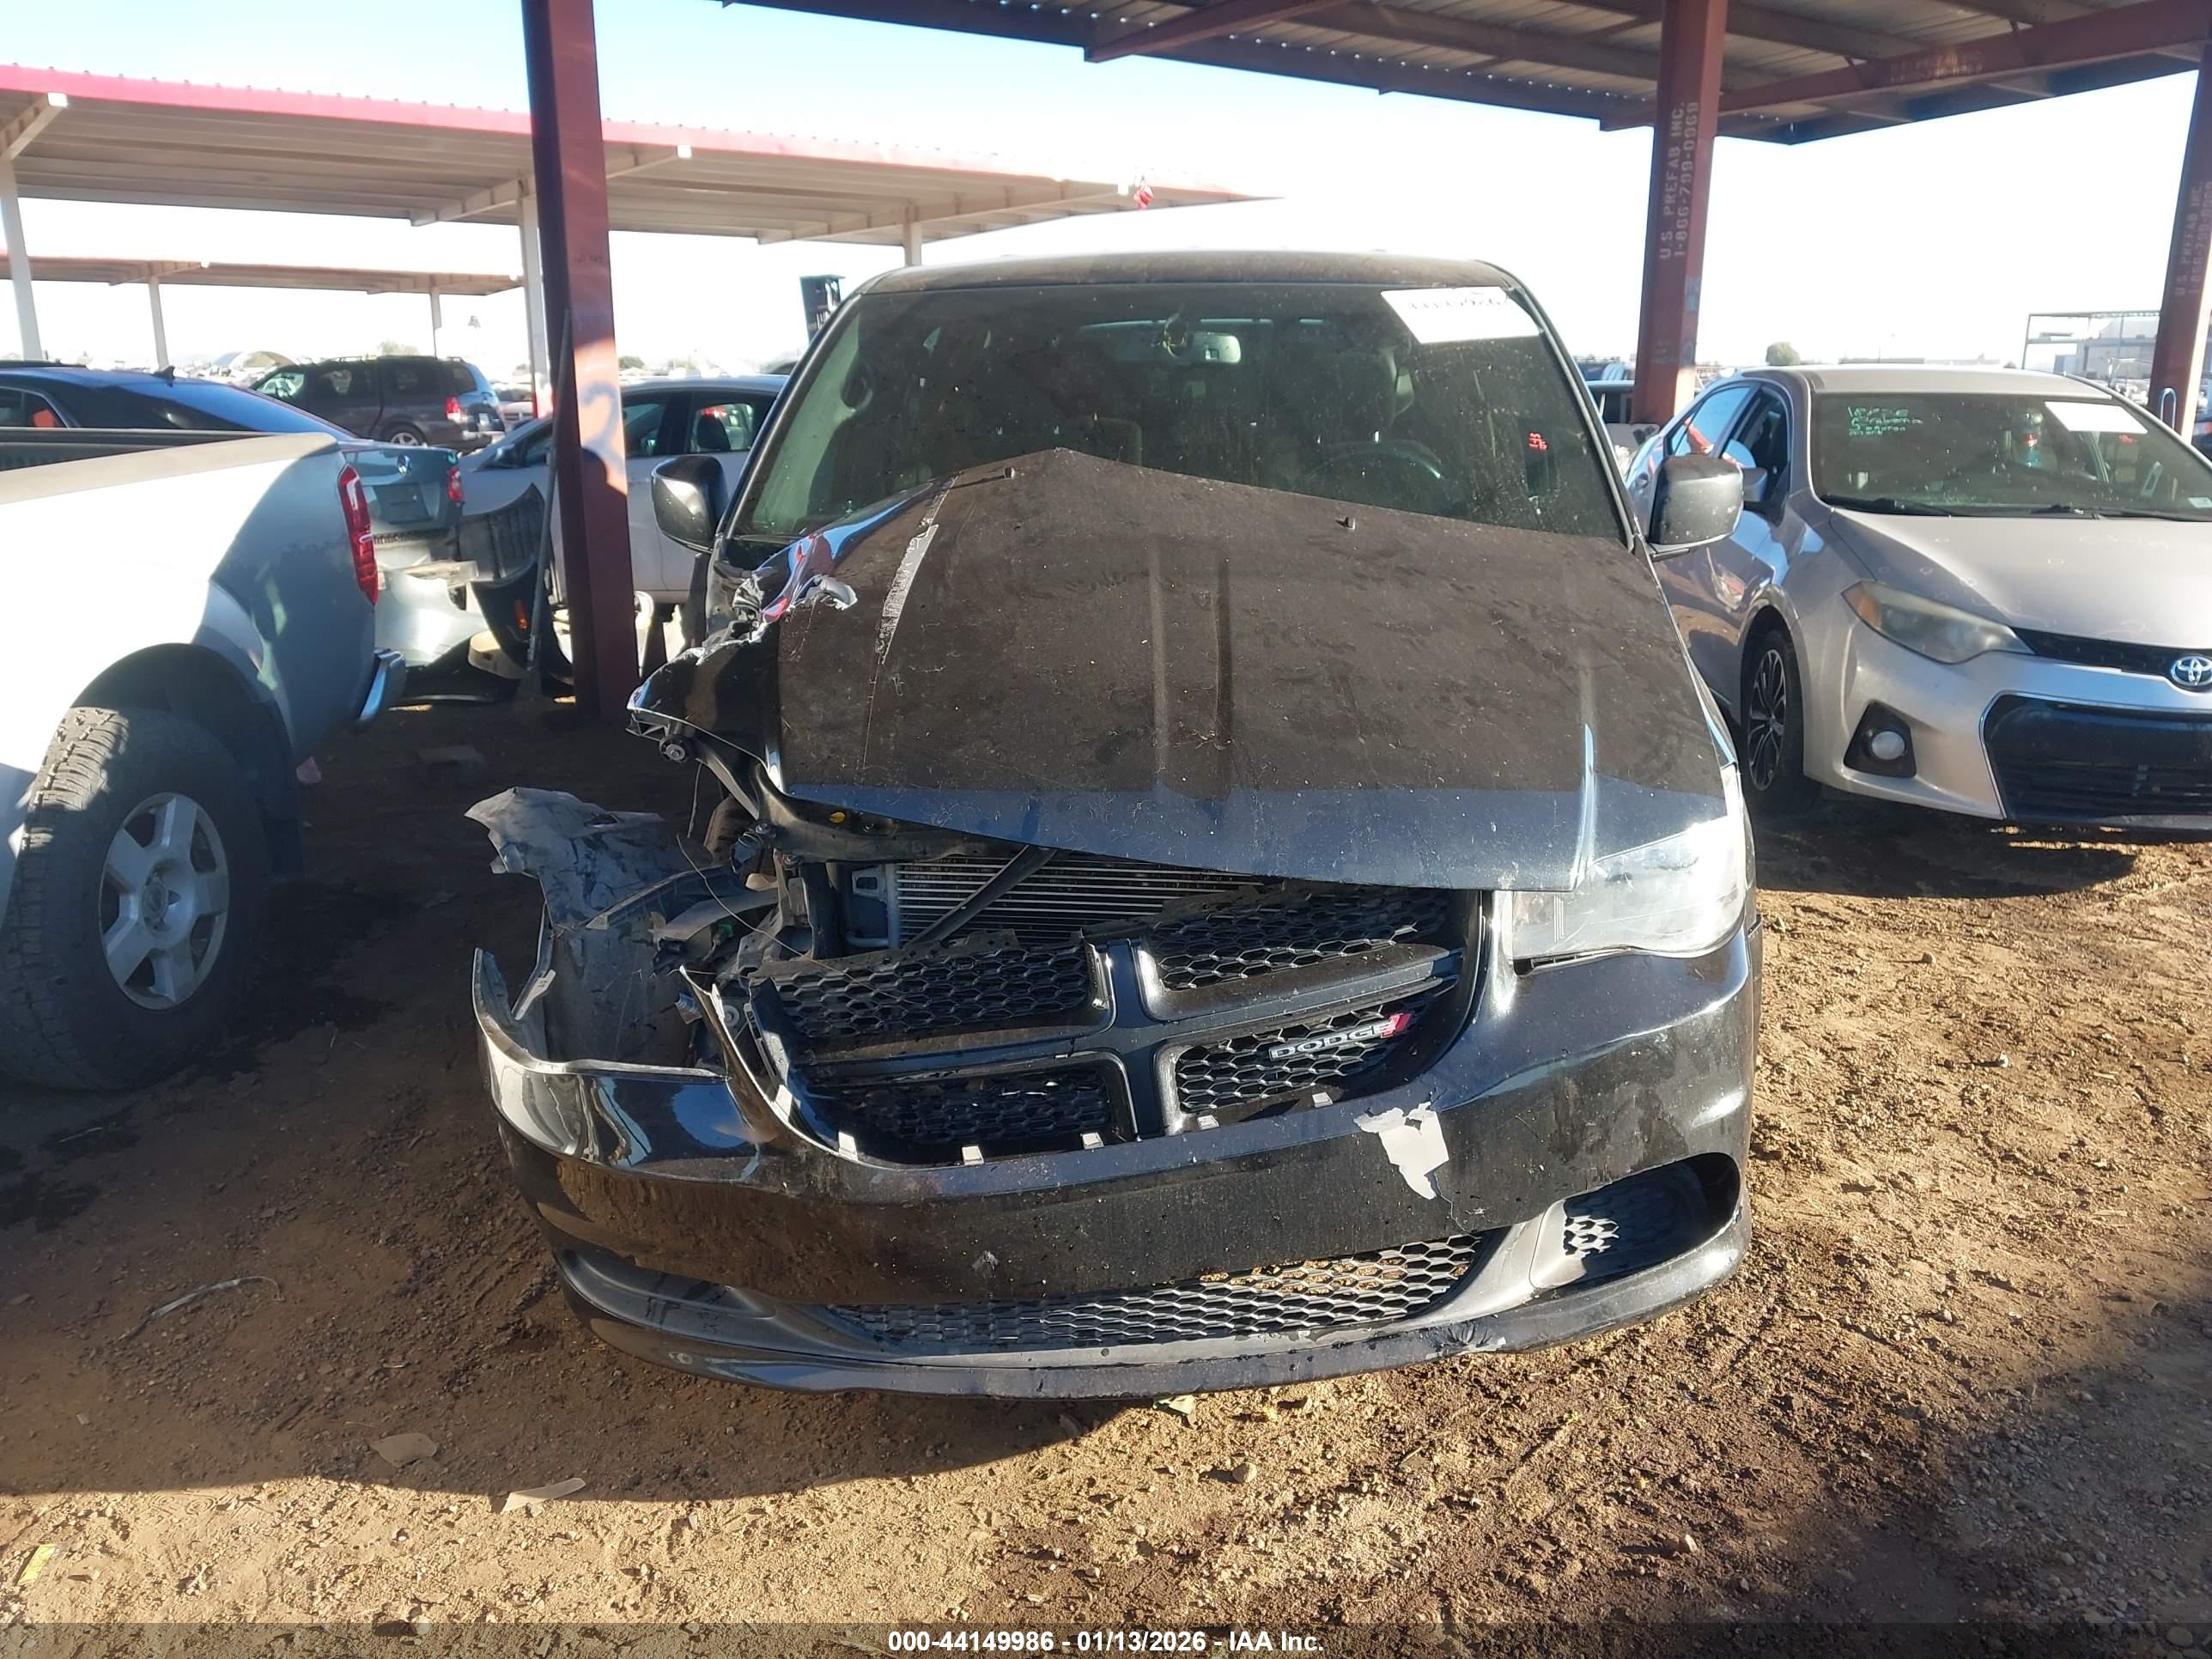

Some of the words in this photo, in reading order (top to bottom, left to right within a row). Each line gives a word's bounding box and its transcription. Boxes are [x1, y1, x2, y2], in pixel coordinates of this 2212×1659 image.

[1662, 145, 1680, 216] PREFAB
[1671, 102, 1686, 137] INC.
[1270, 1018, 1395, 1060] DODGE
